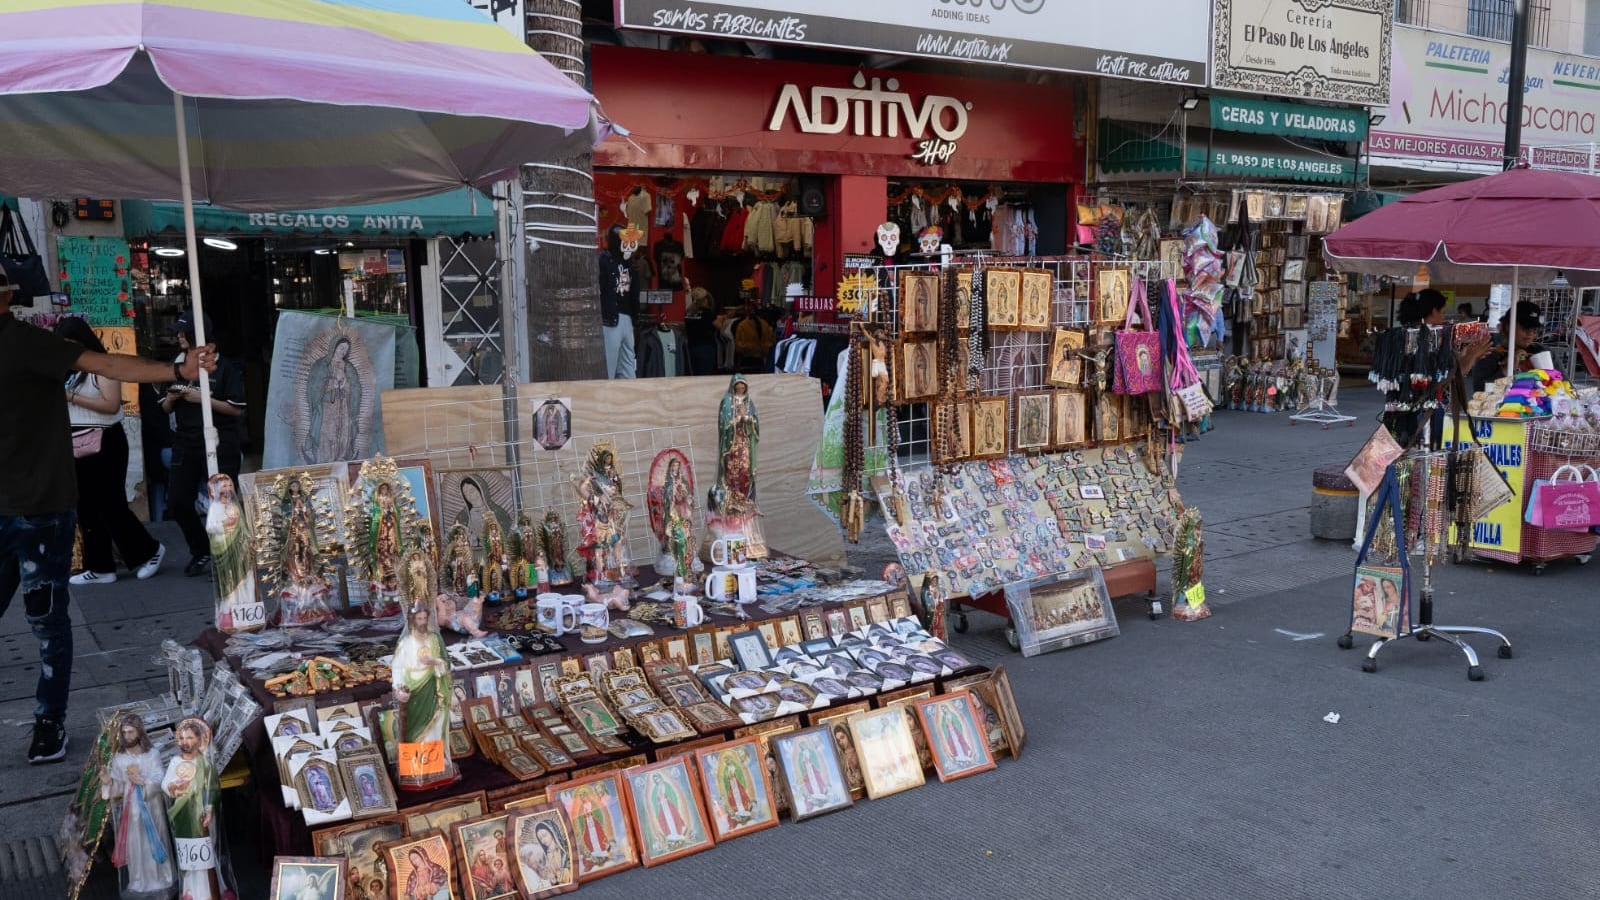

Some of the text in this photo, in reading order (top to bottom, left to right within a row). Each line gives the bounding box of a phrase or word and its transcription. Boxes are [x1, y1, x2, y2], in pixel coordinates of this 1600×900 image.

[653, 7, 807, 40] SOMOS FABRICANTES
[931, 8, 991, 24] ADDING IDEAS
[1244, 24, 1369, 59] El Paso De Los Angeles
[1426, 42, 1490, 65] PALETERIA
[1096, 55, 1128, 76] VENTA
[1127, 61, 1147, 76] POR
[1222, 106, 1356, 133] CERAS Y VELADORAS
[912, 139, 957, 165] SHOP
[1369, 136, 1391, 149] LAS
[1394, 138, 1447, 154] MEJORES
[1449, 143, 1489, 161] AGUAS,
[1216, 154, 1343, 174] EL PASO DE LOS ANGELES
[249, 212, 424, 230] REGALOS ANITA
